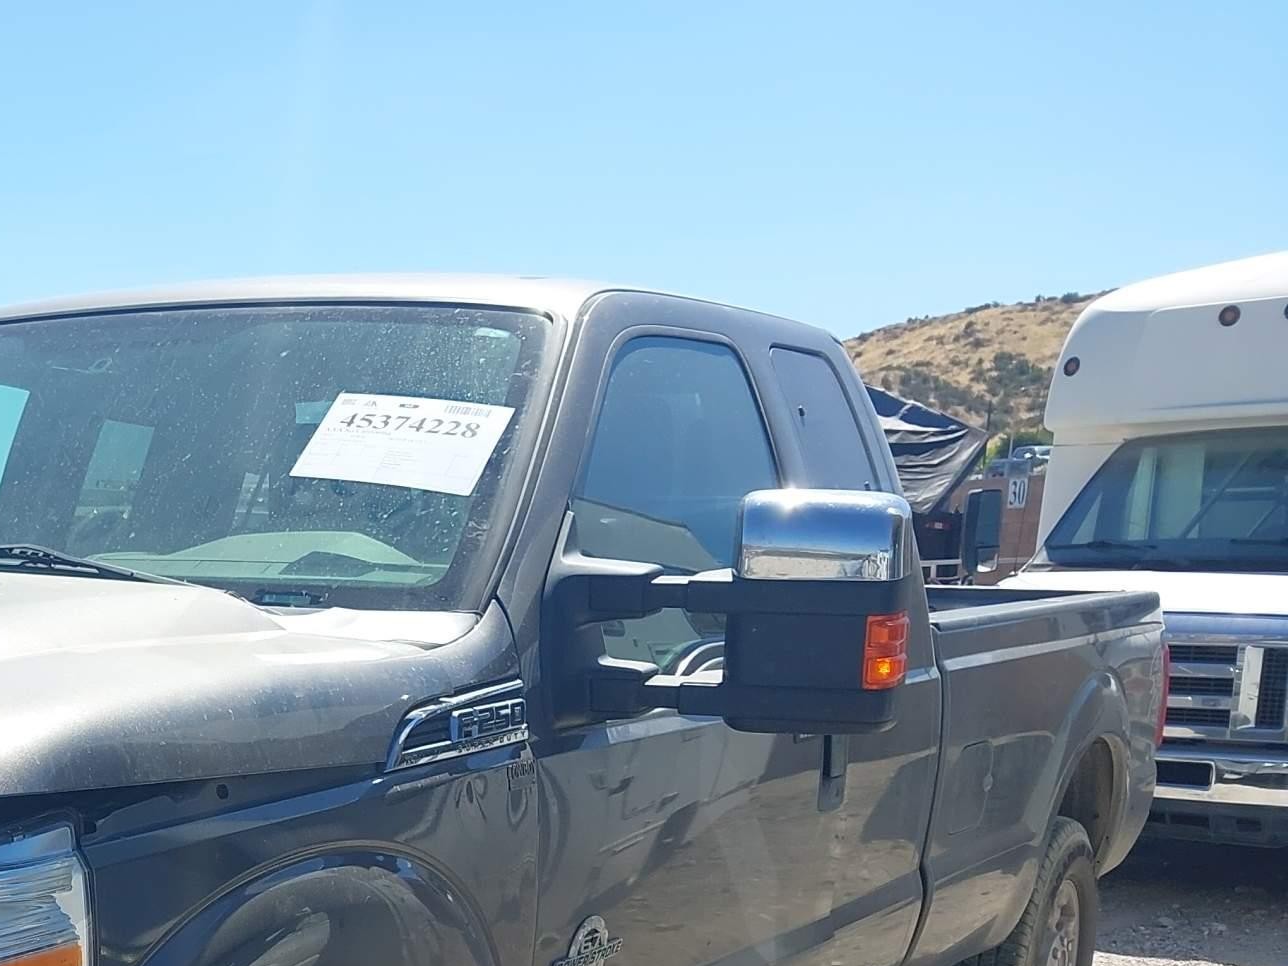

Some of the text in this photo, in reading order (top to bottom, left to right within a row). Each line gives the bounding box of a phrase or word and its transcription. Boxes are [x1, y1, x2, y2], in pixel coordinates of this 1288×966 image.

[339, 412, 481, 439] 45374228
[1009, 480, 1026, 505] 30
[498, 730, 527, 745] DUTY
